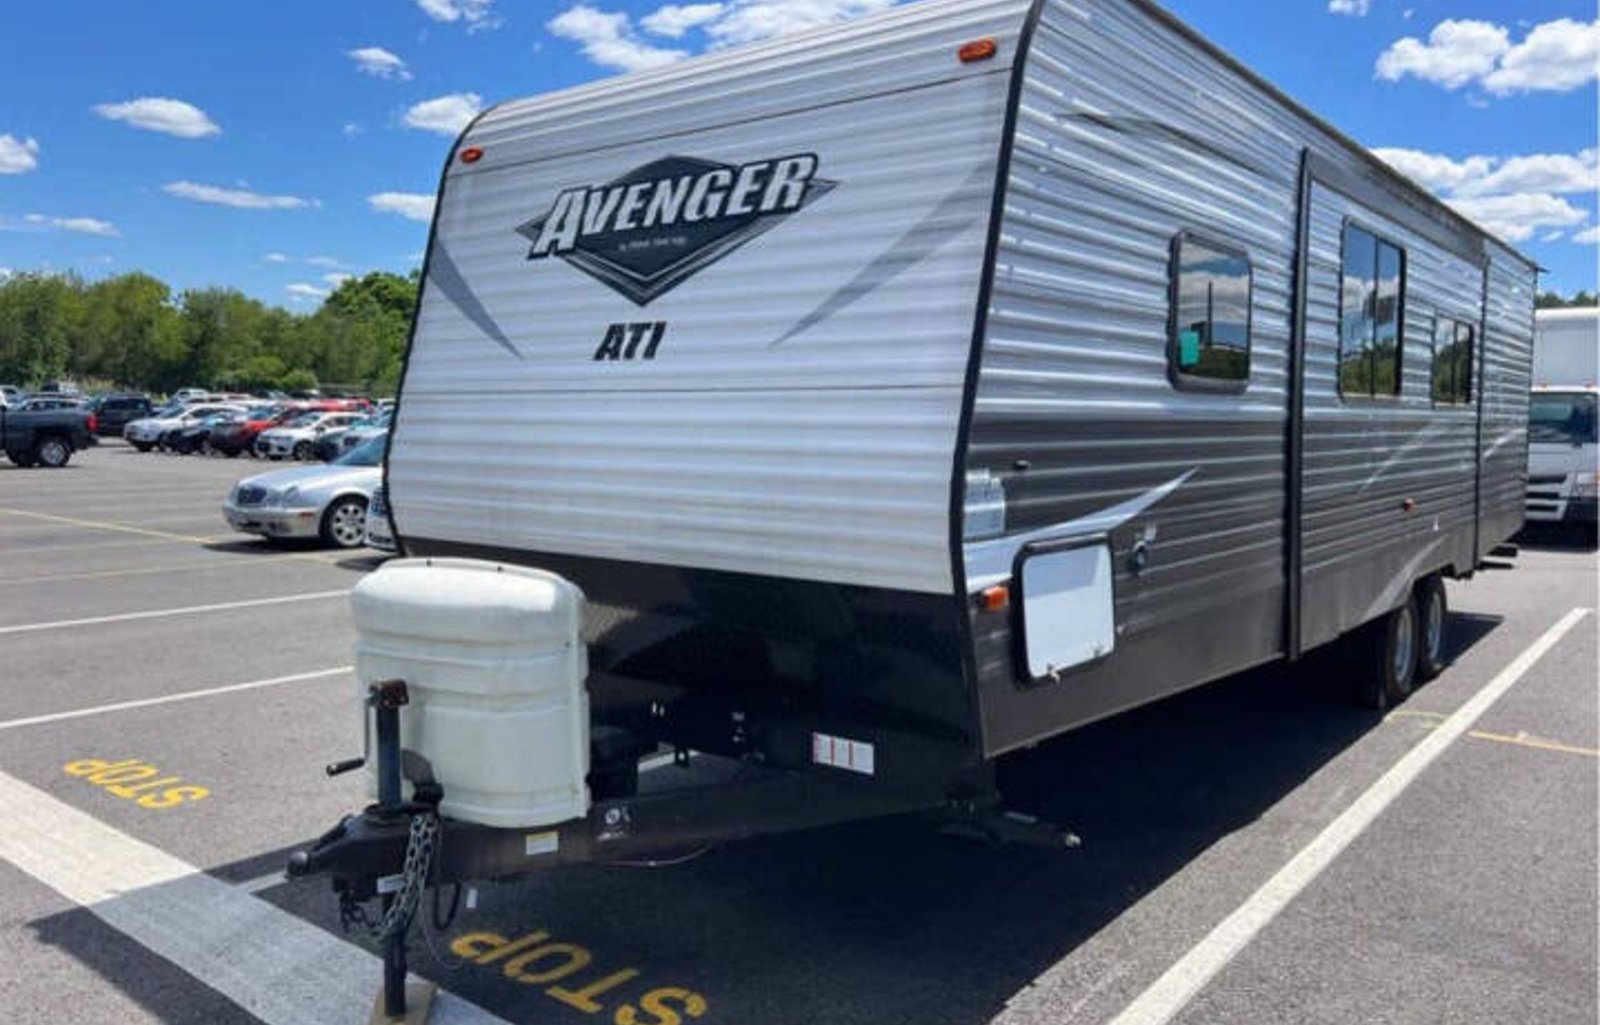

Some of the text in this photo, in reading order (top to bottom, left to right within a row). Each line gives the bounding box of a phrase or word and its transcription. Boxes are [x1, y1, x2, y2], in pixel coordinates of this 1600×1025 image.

[530, 154, 817, 256] AVENGER
[593, 321, 667, 360] ATI
[64, 759, 209, 808] STOP
[451, 931, 707, 1025] STOP
